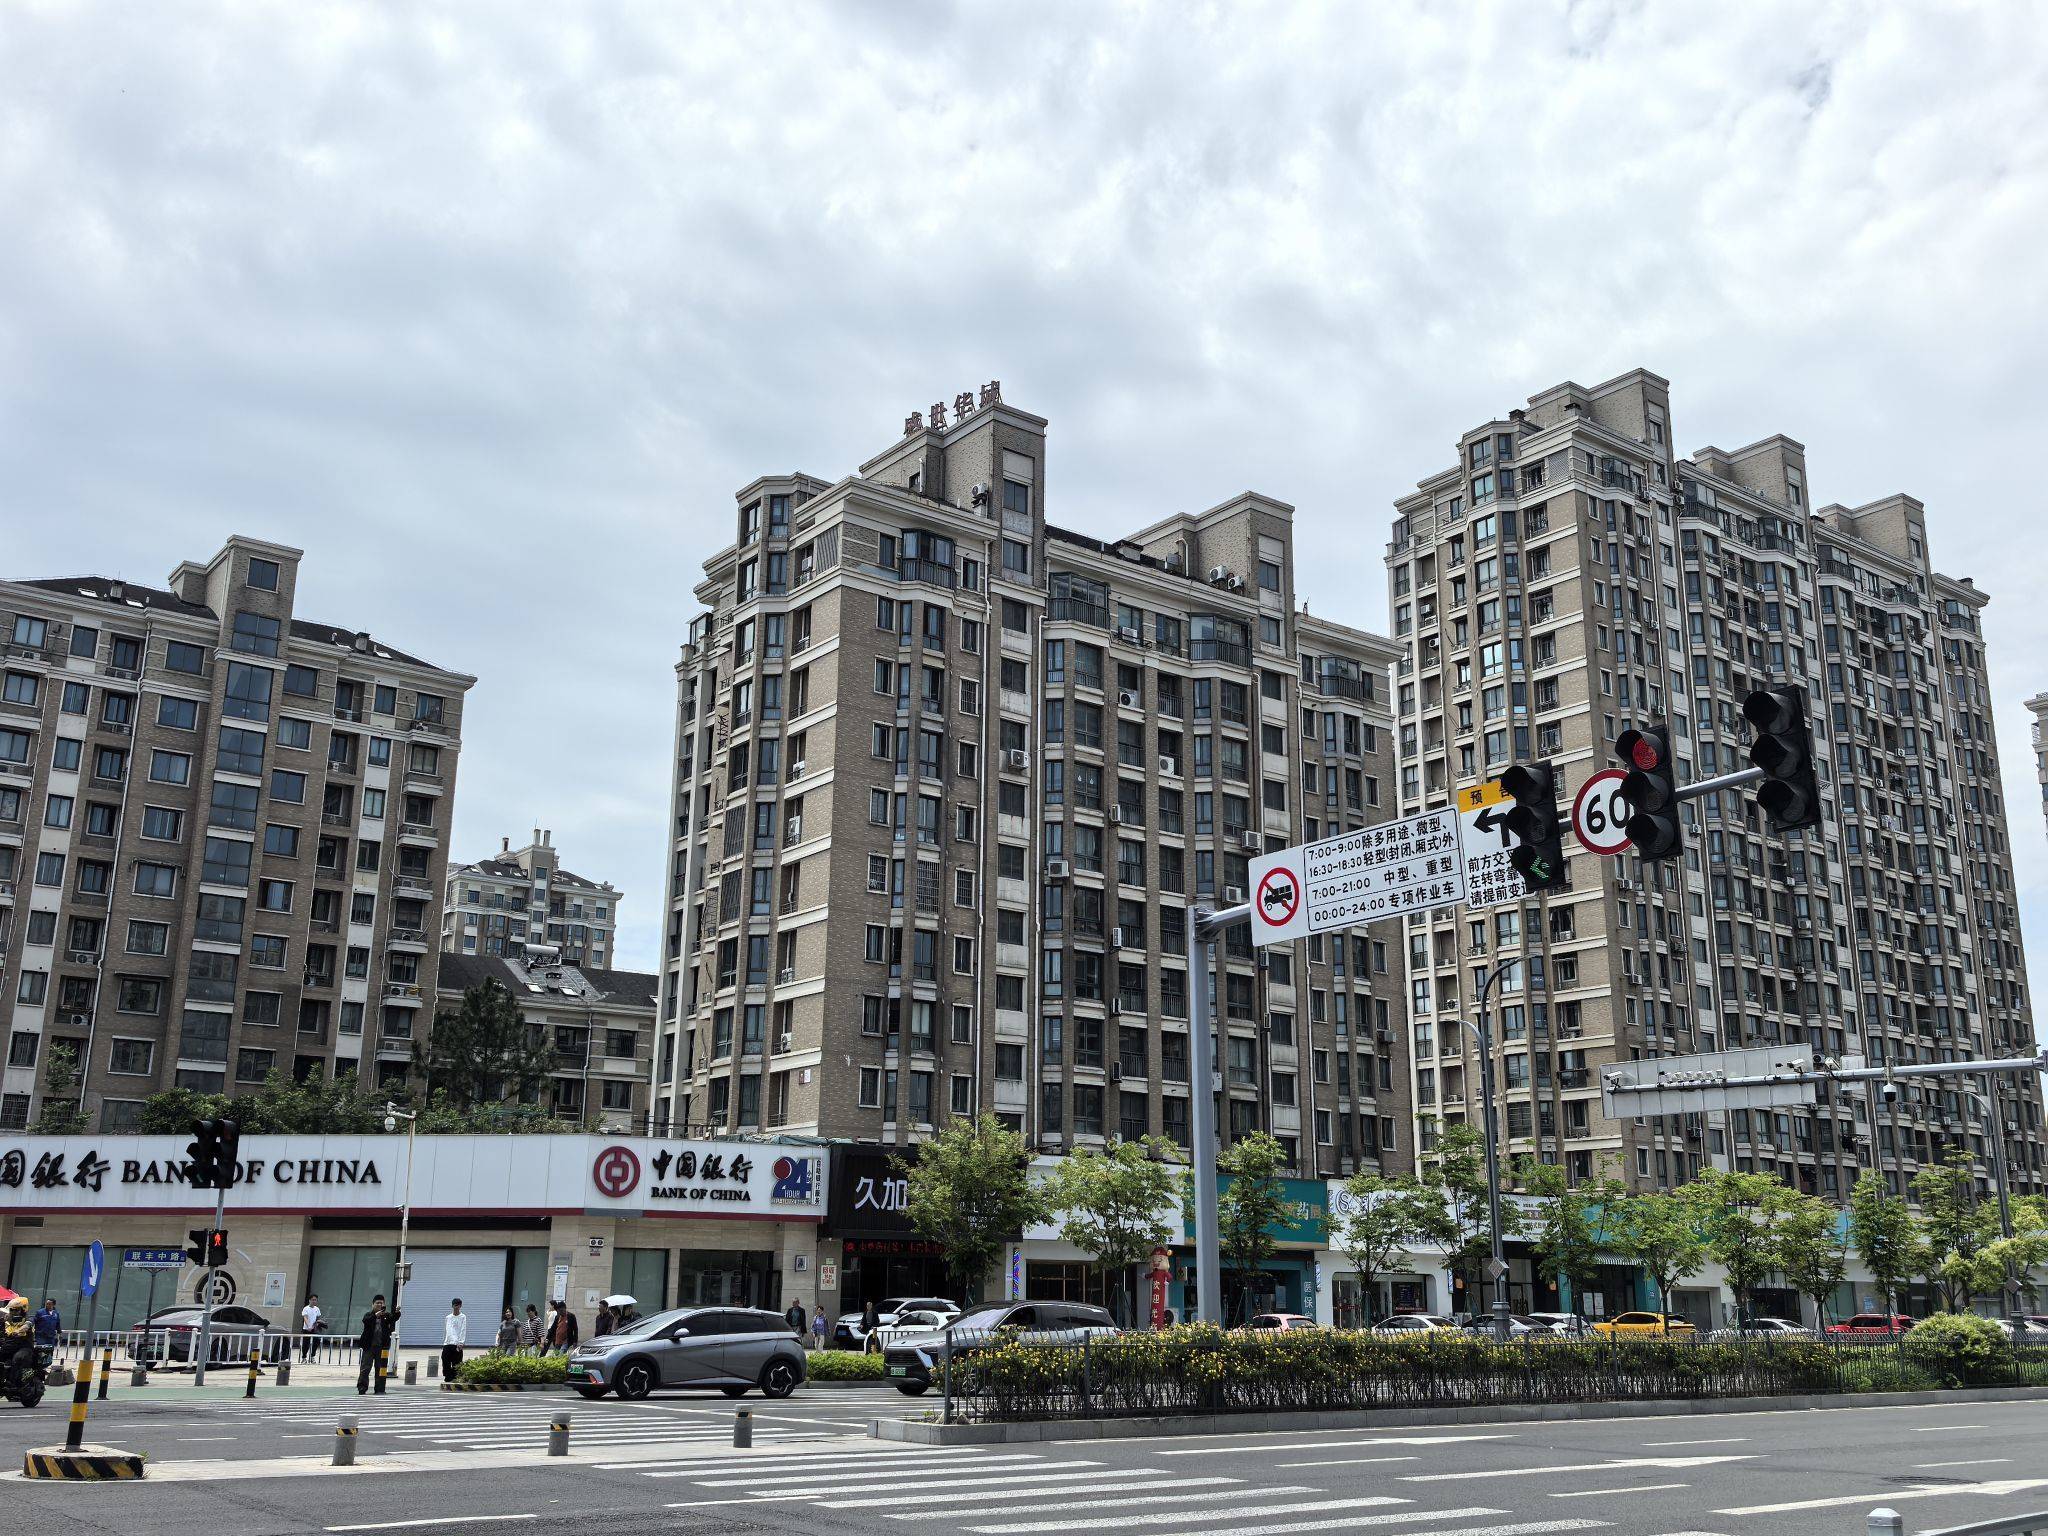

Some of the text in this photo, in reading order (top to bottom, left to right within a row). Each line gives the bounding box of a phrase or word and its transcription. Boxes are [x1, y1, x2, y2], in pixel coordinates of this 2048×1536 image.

[1586, 789, 1631, 835] 60
[1312, 855, 1454, 900] 7:00-21:00 中型、重型
[121, 1160, 196, 1184] BAN
[273, 1160, 382, 1184] CHINA
[651, 1186, 752, 1202] BANK OF CHINA
[784, 1189, 801, 1198] HOUR
[131, 1251, 180, 1261] 联丰中路
